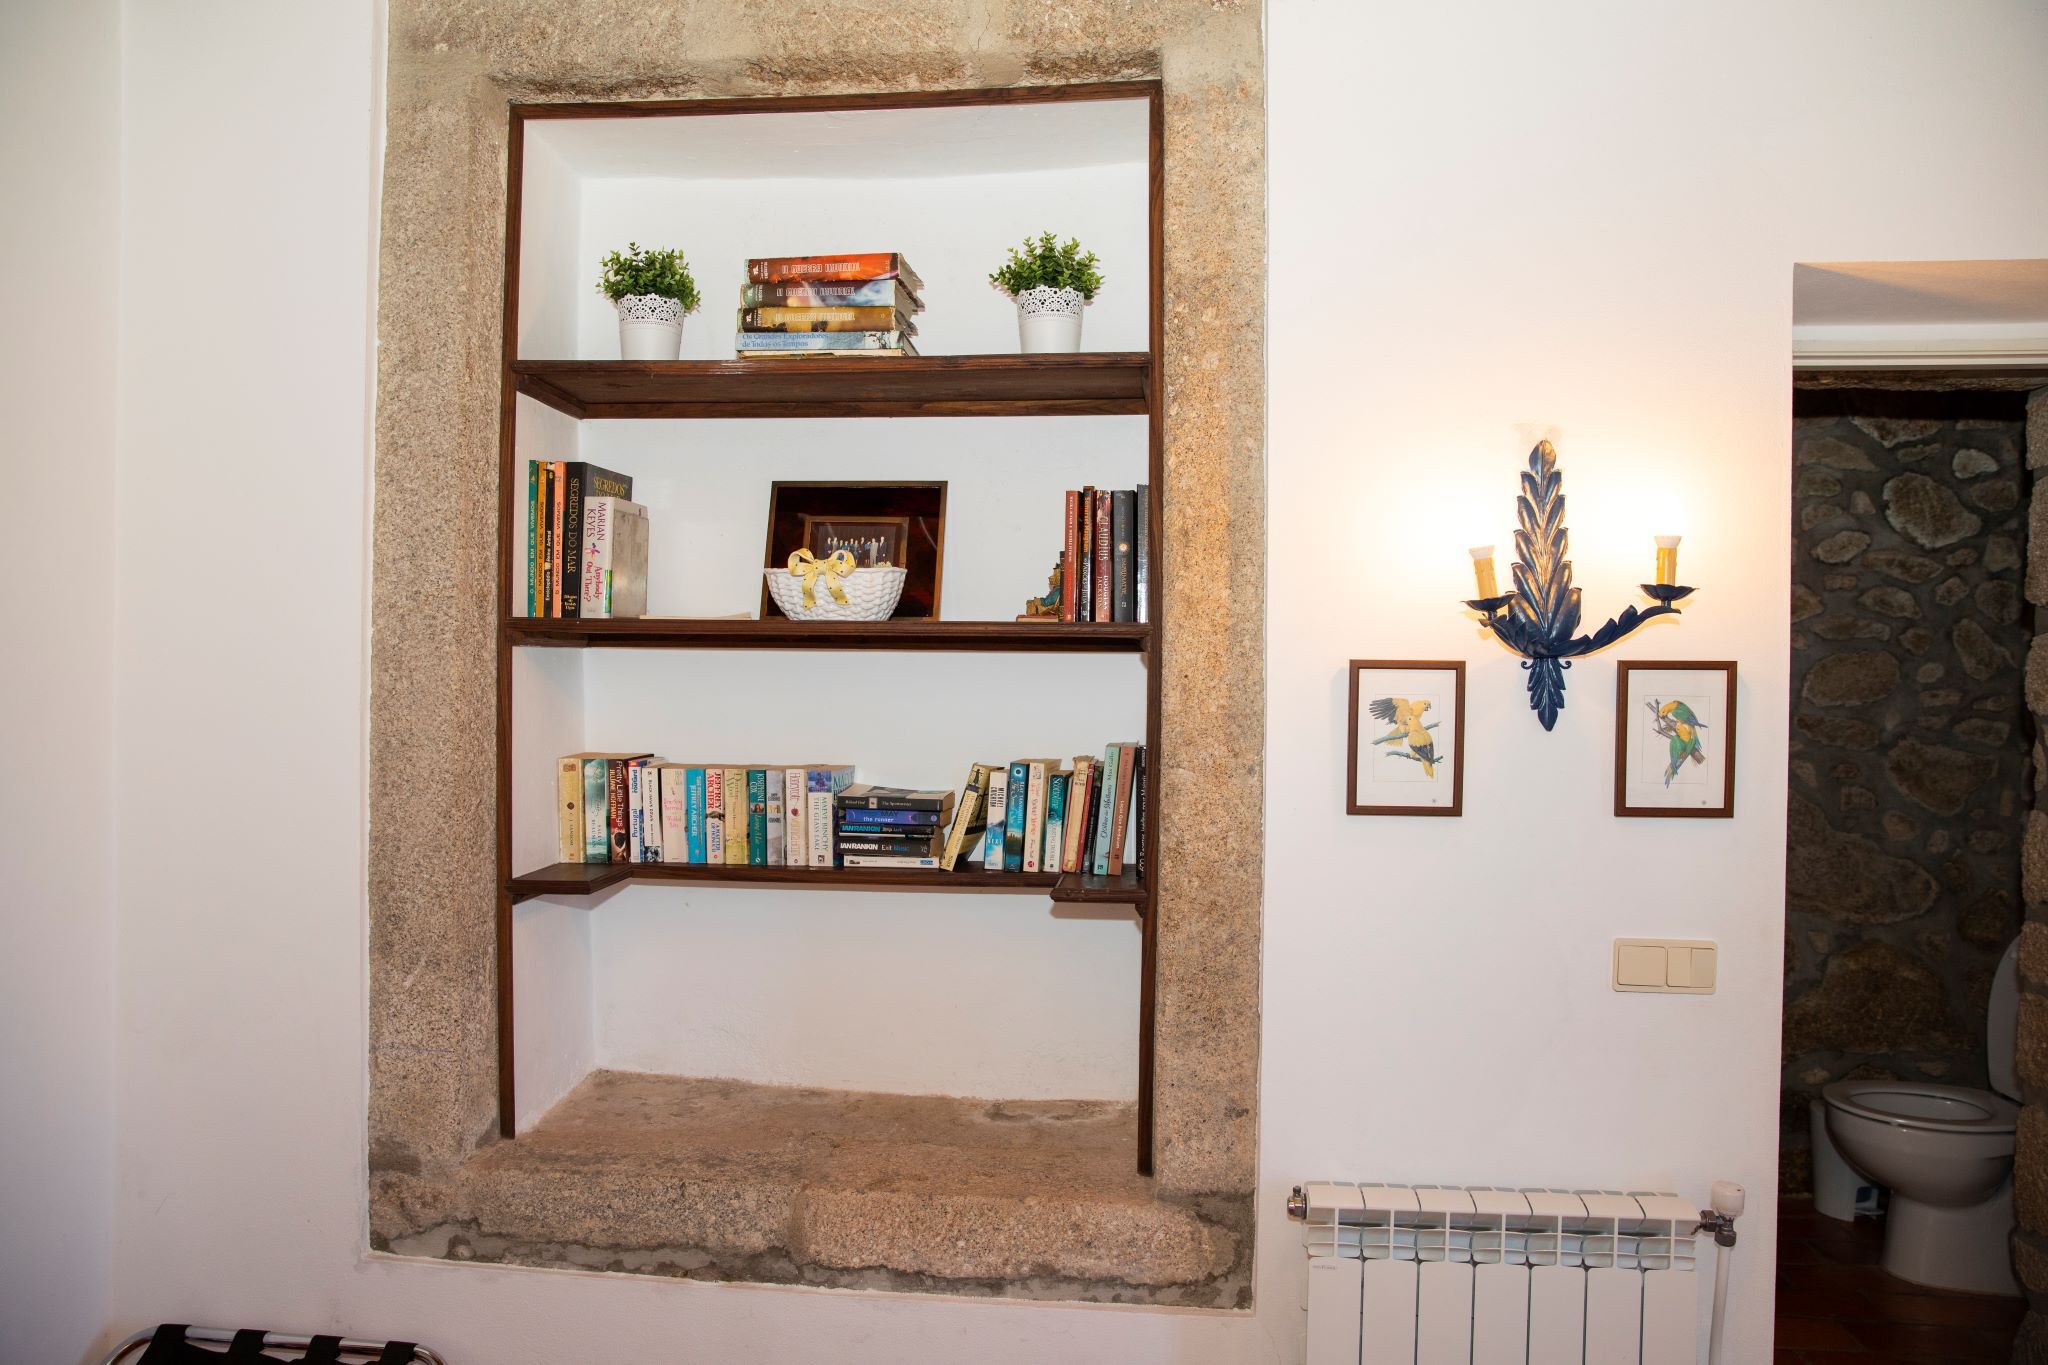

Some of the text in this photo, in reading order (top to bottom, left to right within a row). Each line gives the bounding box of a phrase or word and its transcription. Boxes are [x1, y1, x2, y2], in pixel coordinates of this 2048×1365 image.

[791, 263, 822, 273] GUERRA
[825, 262, 860, 272] MUNDIAL
[782, 340, 809, 348] Tempos
[783, 333, 828, 341] Exploradores
[568, 478, 579, 573] SEGREDOS DO MAR
[586, 508, 596, 538] KEYES
[596, 502, 606, 541] MARIAN
[1098, 517, 1110, 560] CLAUDIUS
[530, 549, 535, 559] EM
[538, 550, 544, 559] EM
[556, 550, 561, 559] EM
[584, 561, 593, 602] Out There?
[593, 566, 603, 600] Anybody
[714, 772, 722, 810] JEFFREY
[750, 781, 758, 793] COX
[1052, 778, 1062, 809] Scottoline
[616, 803, 624, 827] Things
